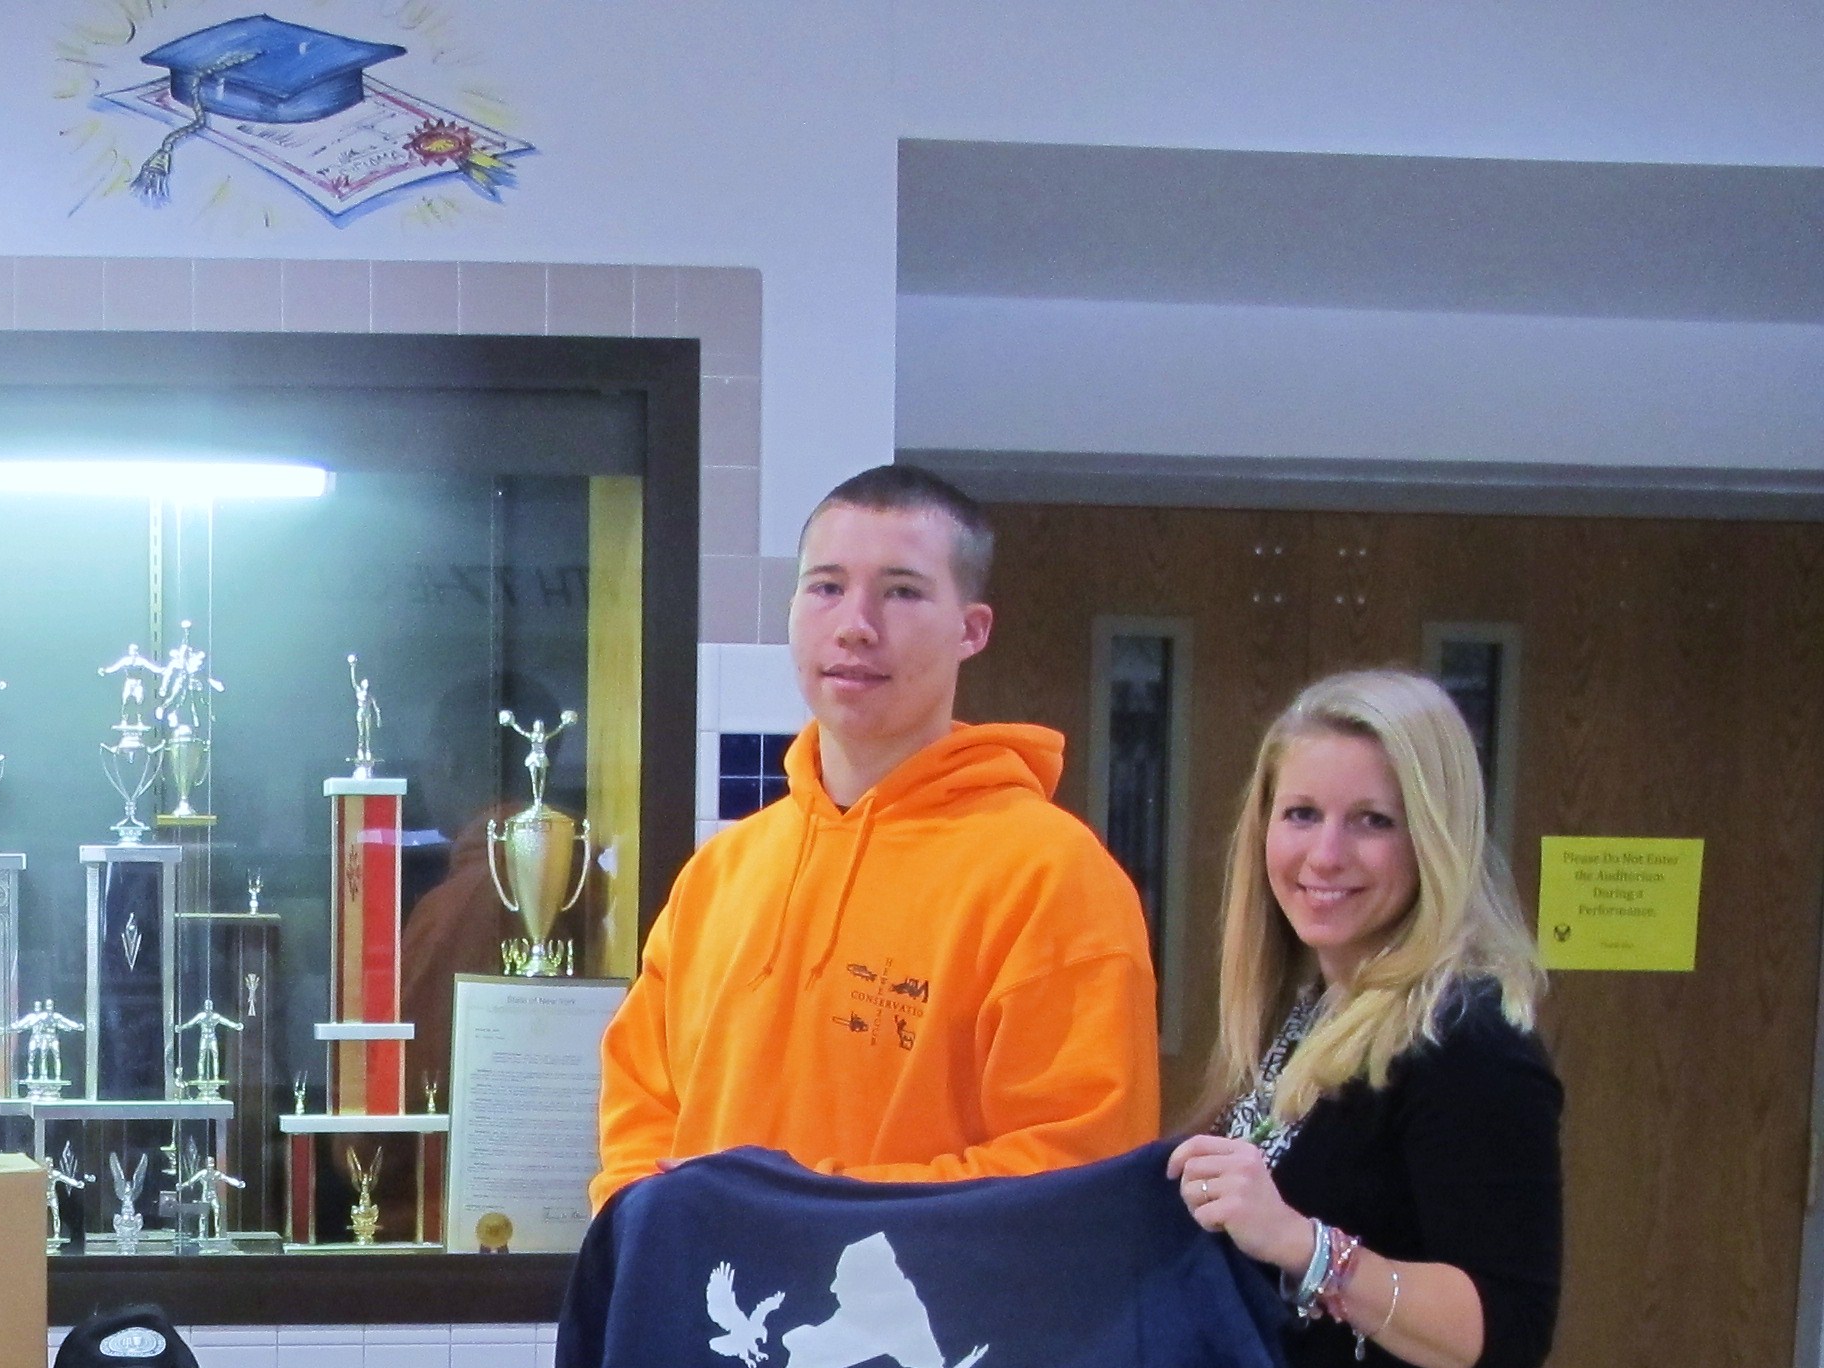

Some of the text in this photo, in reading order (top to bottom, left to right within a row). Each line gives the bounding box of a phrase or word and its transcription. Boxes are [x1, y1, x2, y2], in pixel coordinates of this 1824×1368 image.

[1563, 851, 1679, 865] Please Do Not Enter
[1575, 870, 1593, 881] the
[1593, 887, 1634, 900] During
